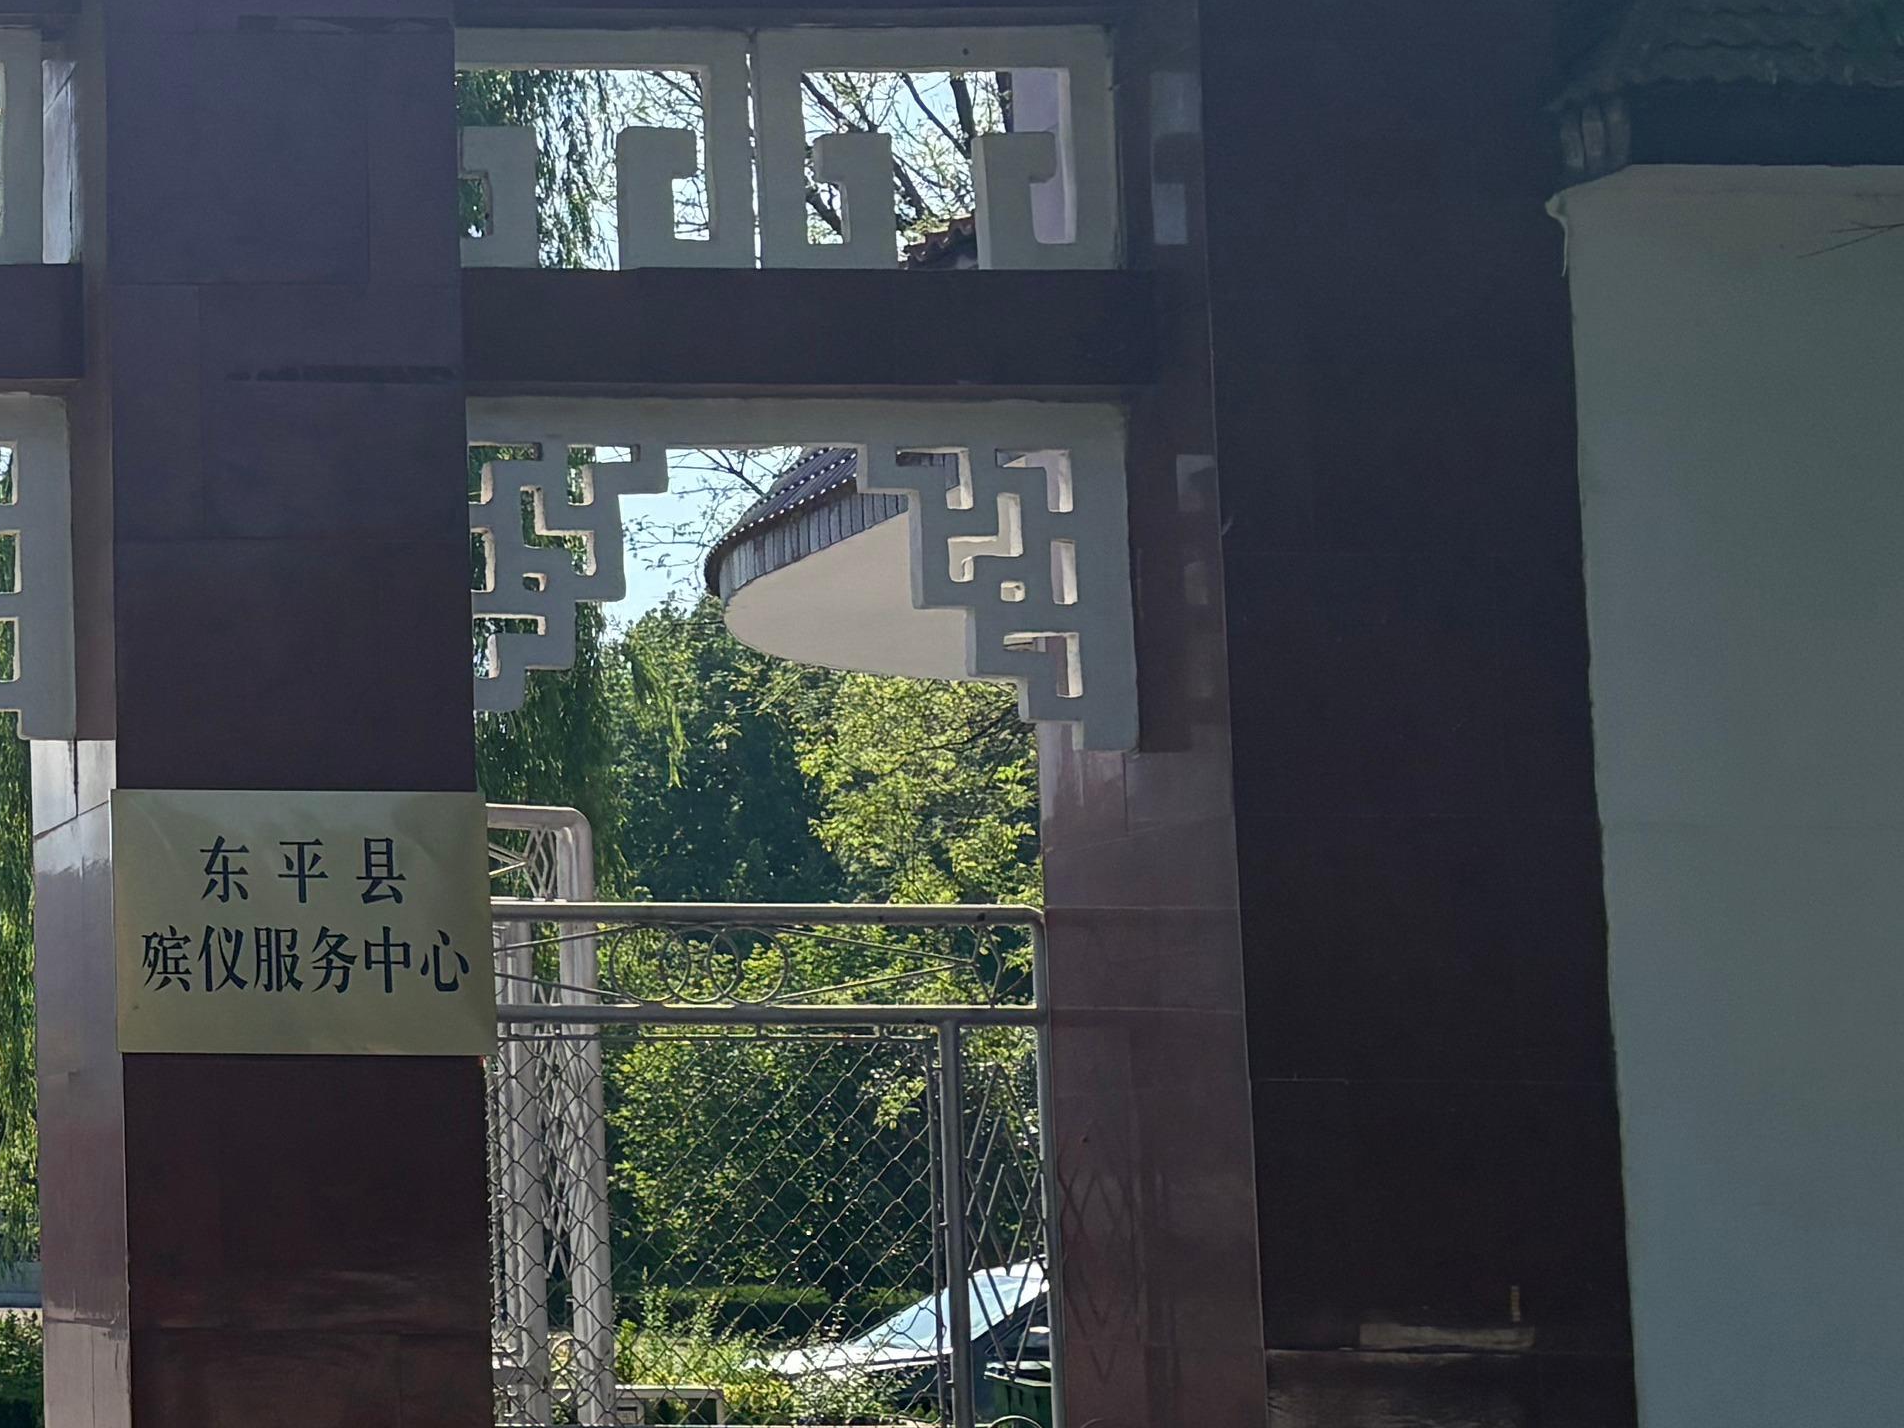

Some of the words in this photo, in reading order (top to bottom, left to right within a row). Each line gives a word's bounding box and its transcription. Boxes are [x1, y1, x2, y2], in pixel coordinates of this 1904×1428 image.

[199, 835, 406, 904] 东平县
[141, 924, 470, 993] 殡仪服务中心
